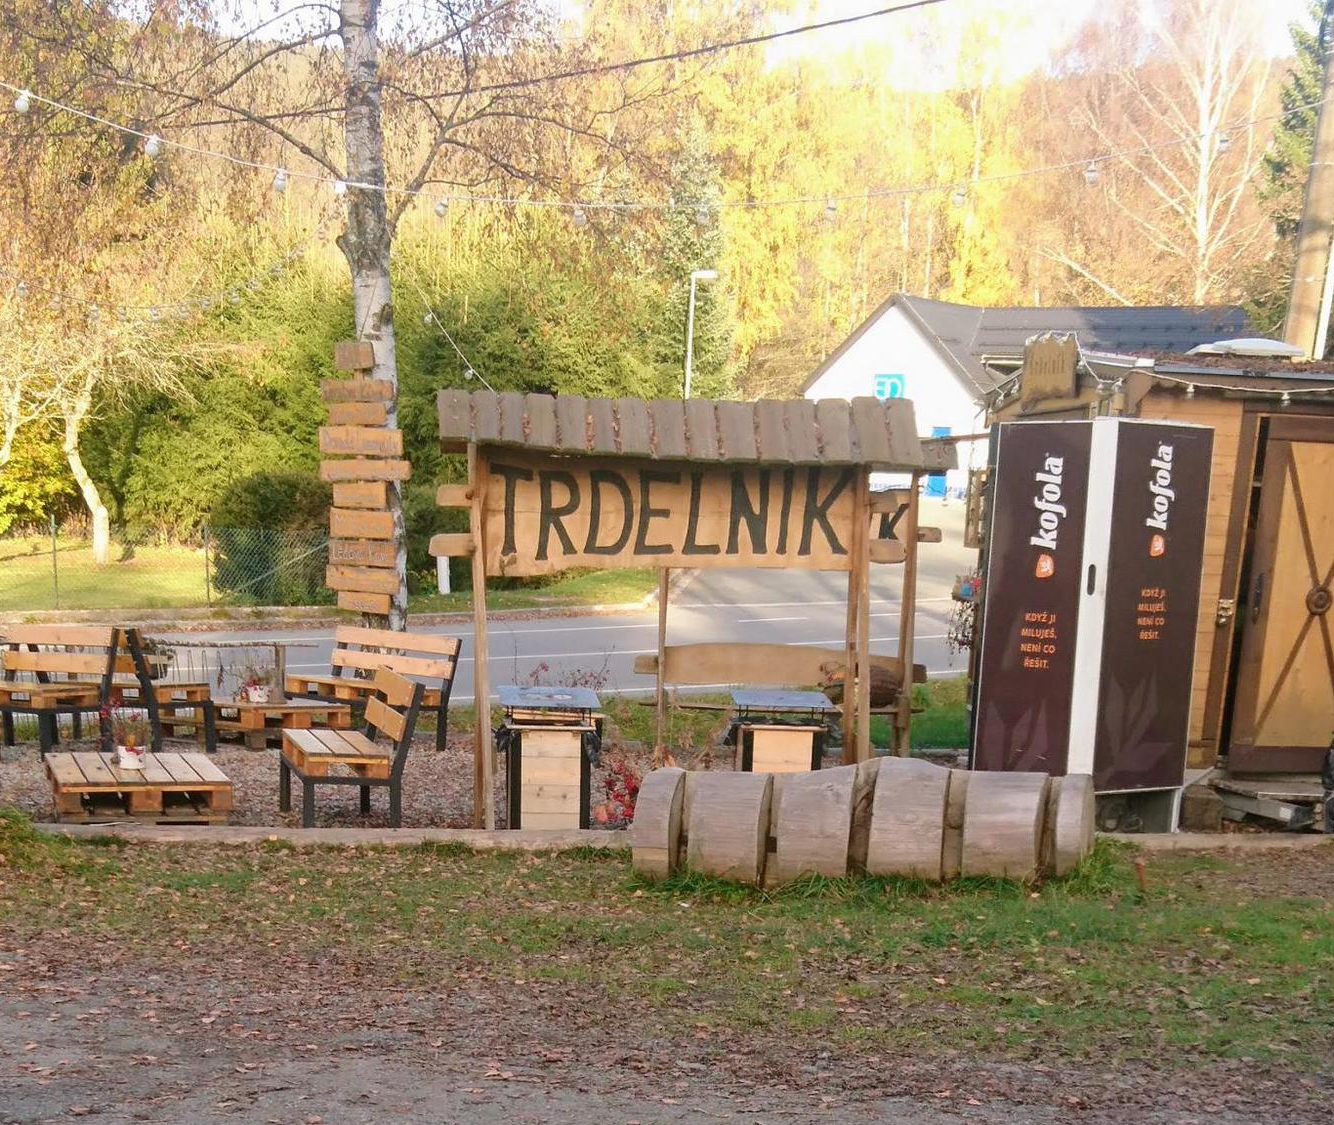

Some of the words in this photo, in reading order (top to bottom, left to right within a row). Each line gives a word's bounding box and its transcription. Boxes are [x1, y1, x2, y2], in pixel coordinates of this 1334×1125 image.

[490, 463, 855, 560] TRDELNIK
[1030, 456, 1066, 550] kofola
[1146, 445, 1174, 530] kofola
[1020, 642, 1041, 653] NENÍ
[1043, 644, 1056, 654] CO
[1025, 611, 1047, 622] KDYŽ
[1048, 614, 1056, 624] JI
